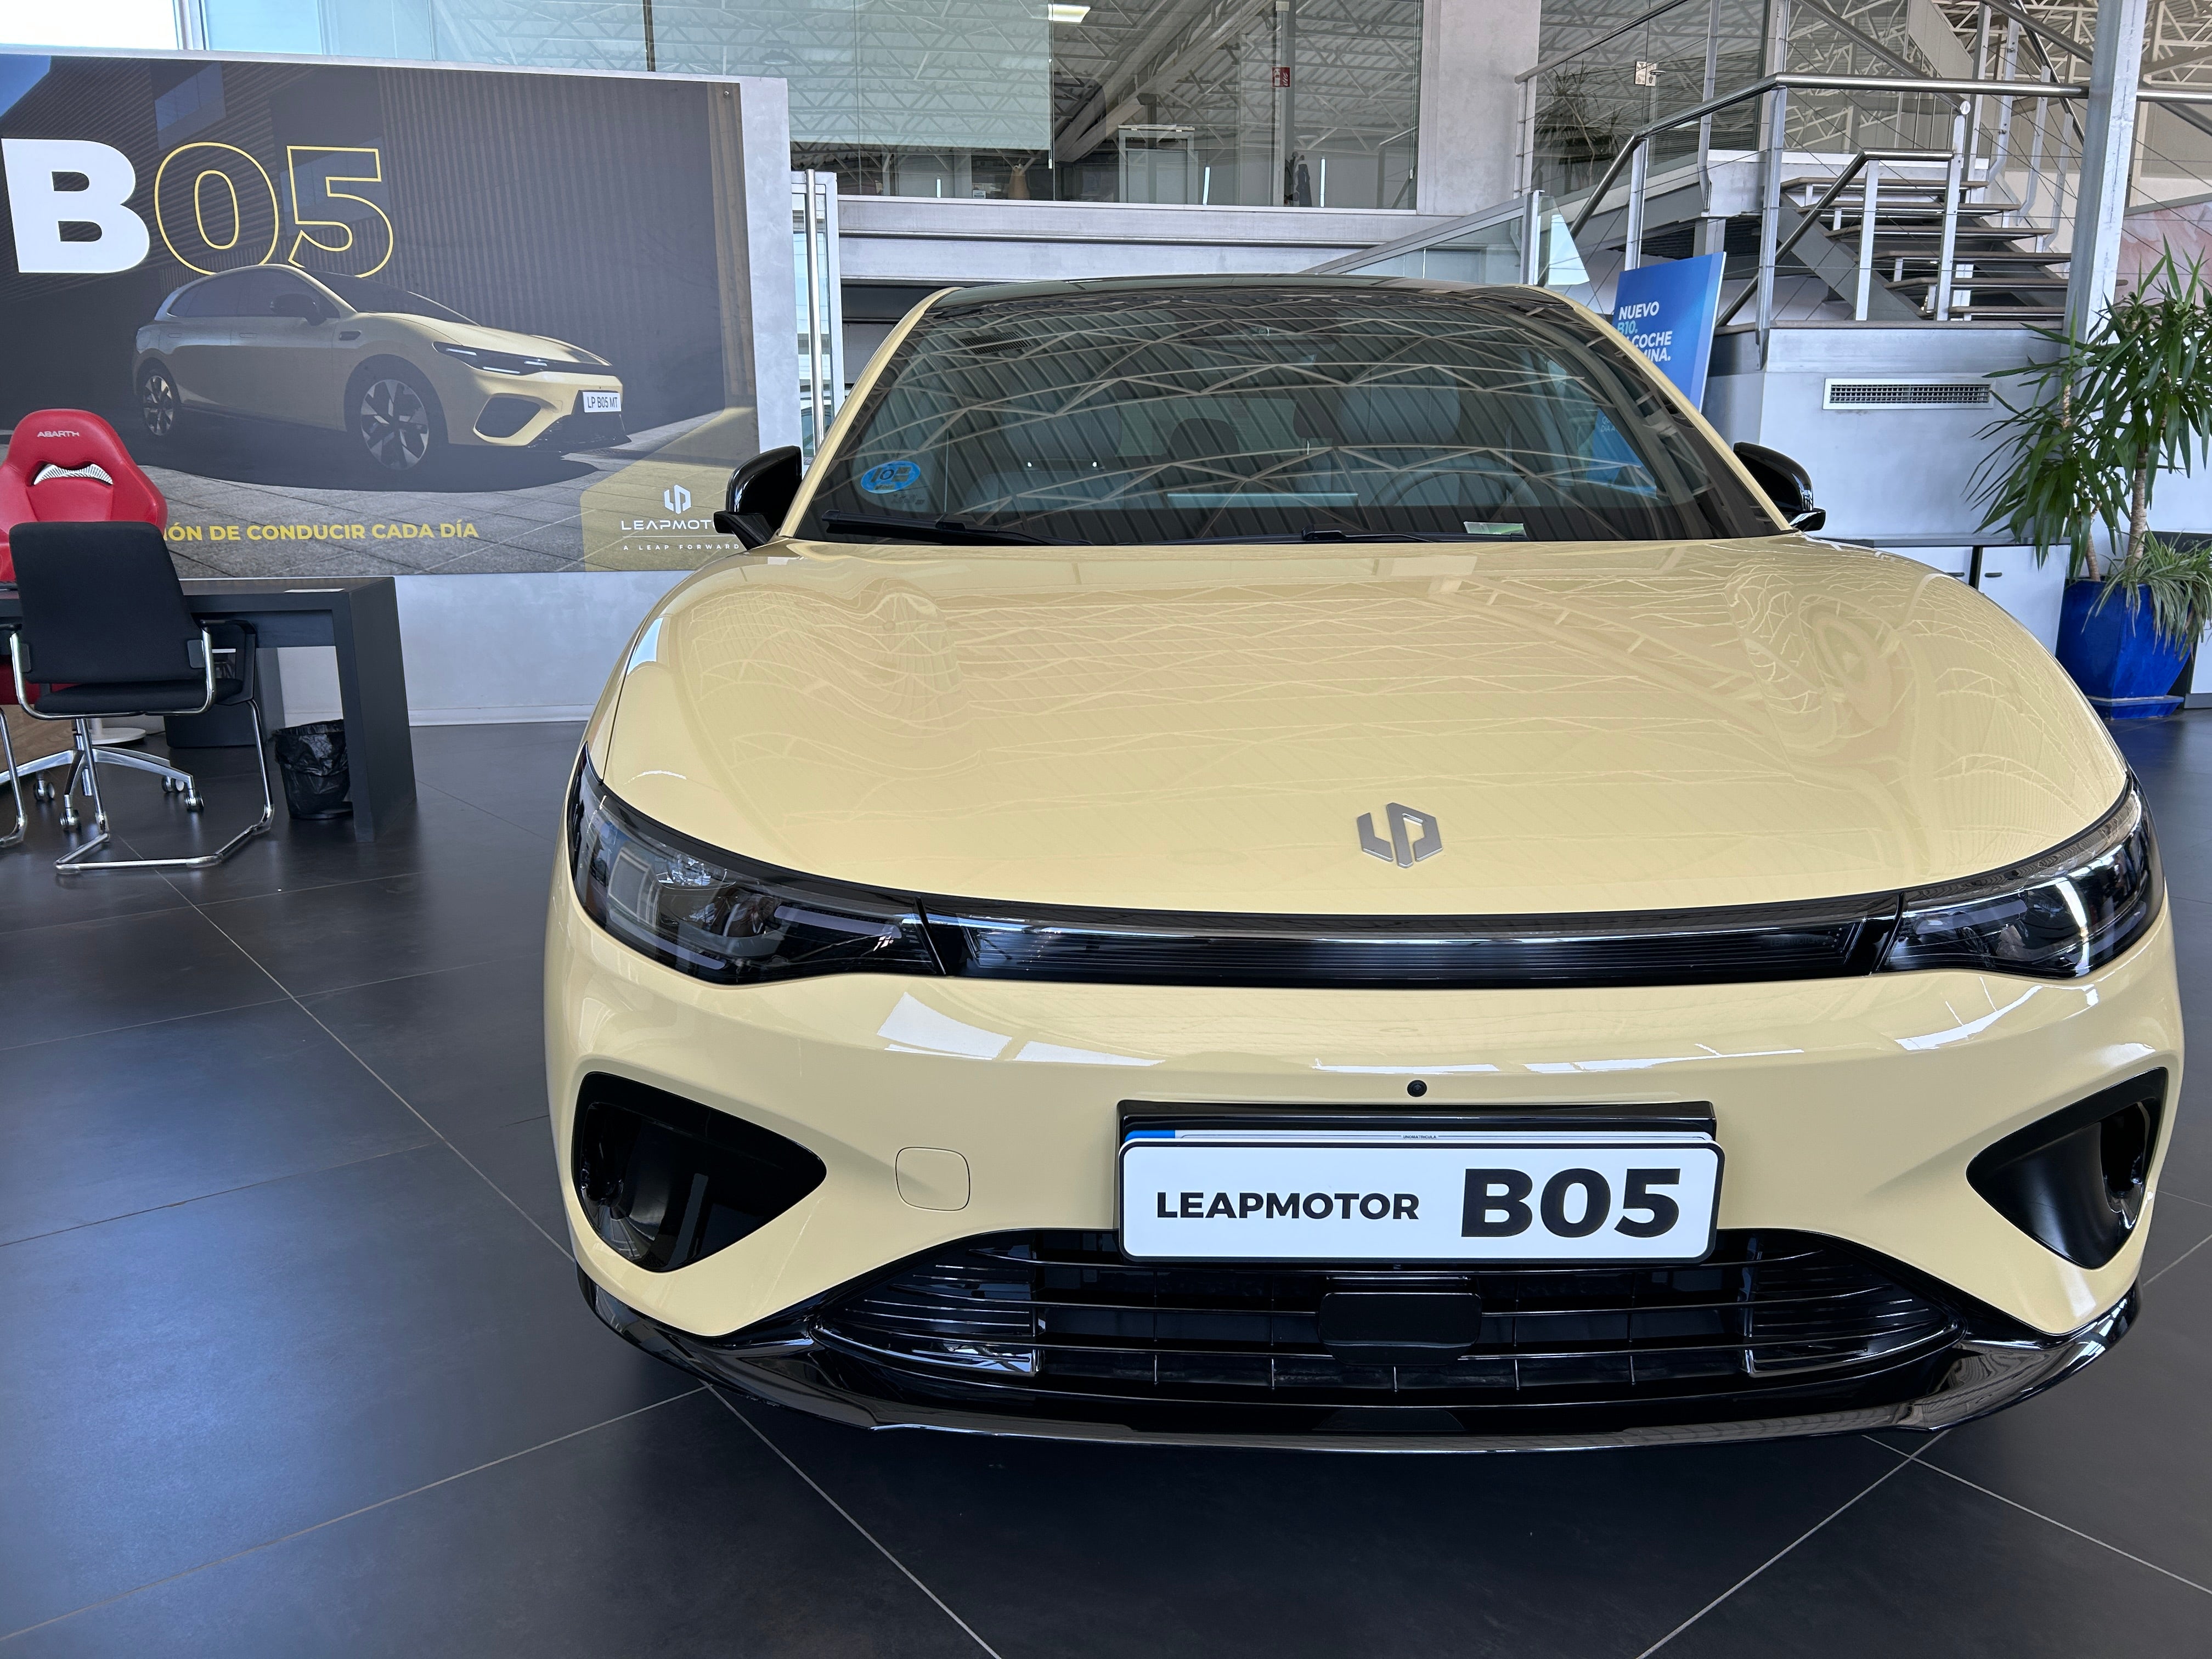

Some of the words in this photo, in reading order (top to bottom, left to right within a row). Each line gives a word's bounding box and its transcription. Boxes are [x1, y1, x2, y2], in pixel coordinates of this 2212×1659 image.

[1, 138, 393, 278] B05
[1619, 301, 1659, 320] NUEVO
[1617, 320, 1638, 335] B10.
[1632, 330, 1673, 348] COCHE
[587, 396, 596, 408] LP
[597, 397, 609, 408] B05
[610, 397, 618, 408] MT
[209, 525, 241, 541] DE
[247, 524, 365, 540] CONDUCIR
[371, 523, 433, 539] CADA
[441, 519, 479, 538] DÍA
[621, 520, 715, 531] LEAPMOT
[1156, 1192, 1419, 1220] LEAPMOTOR
[1461, 1167, 1681, 1239] B05
